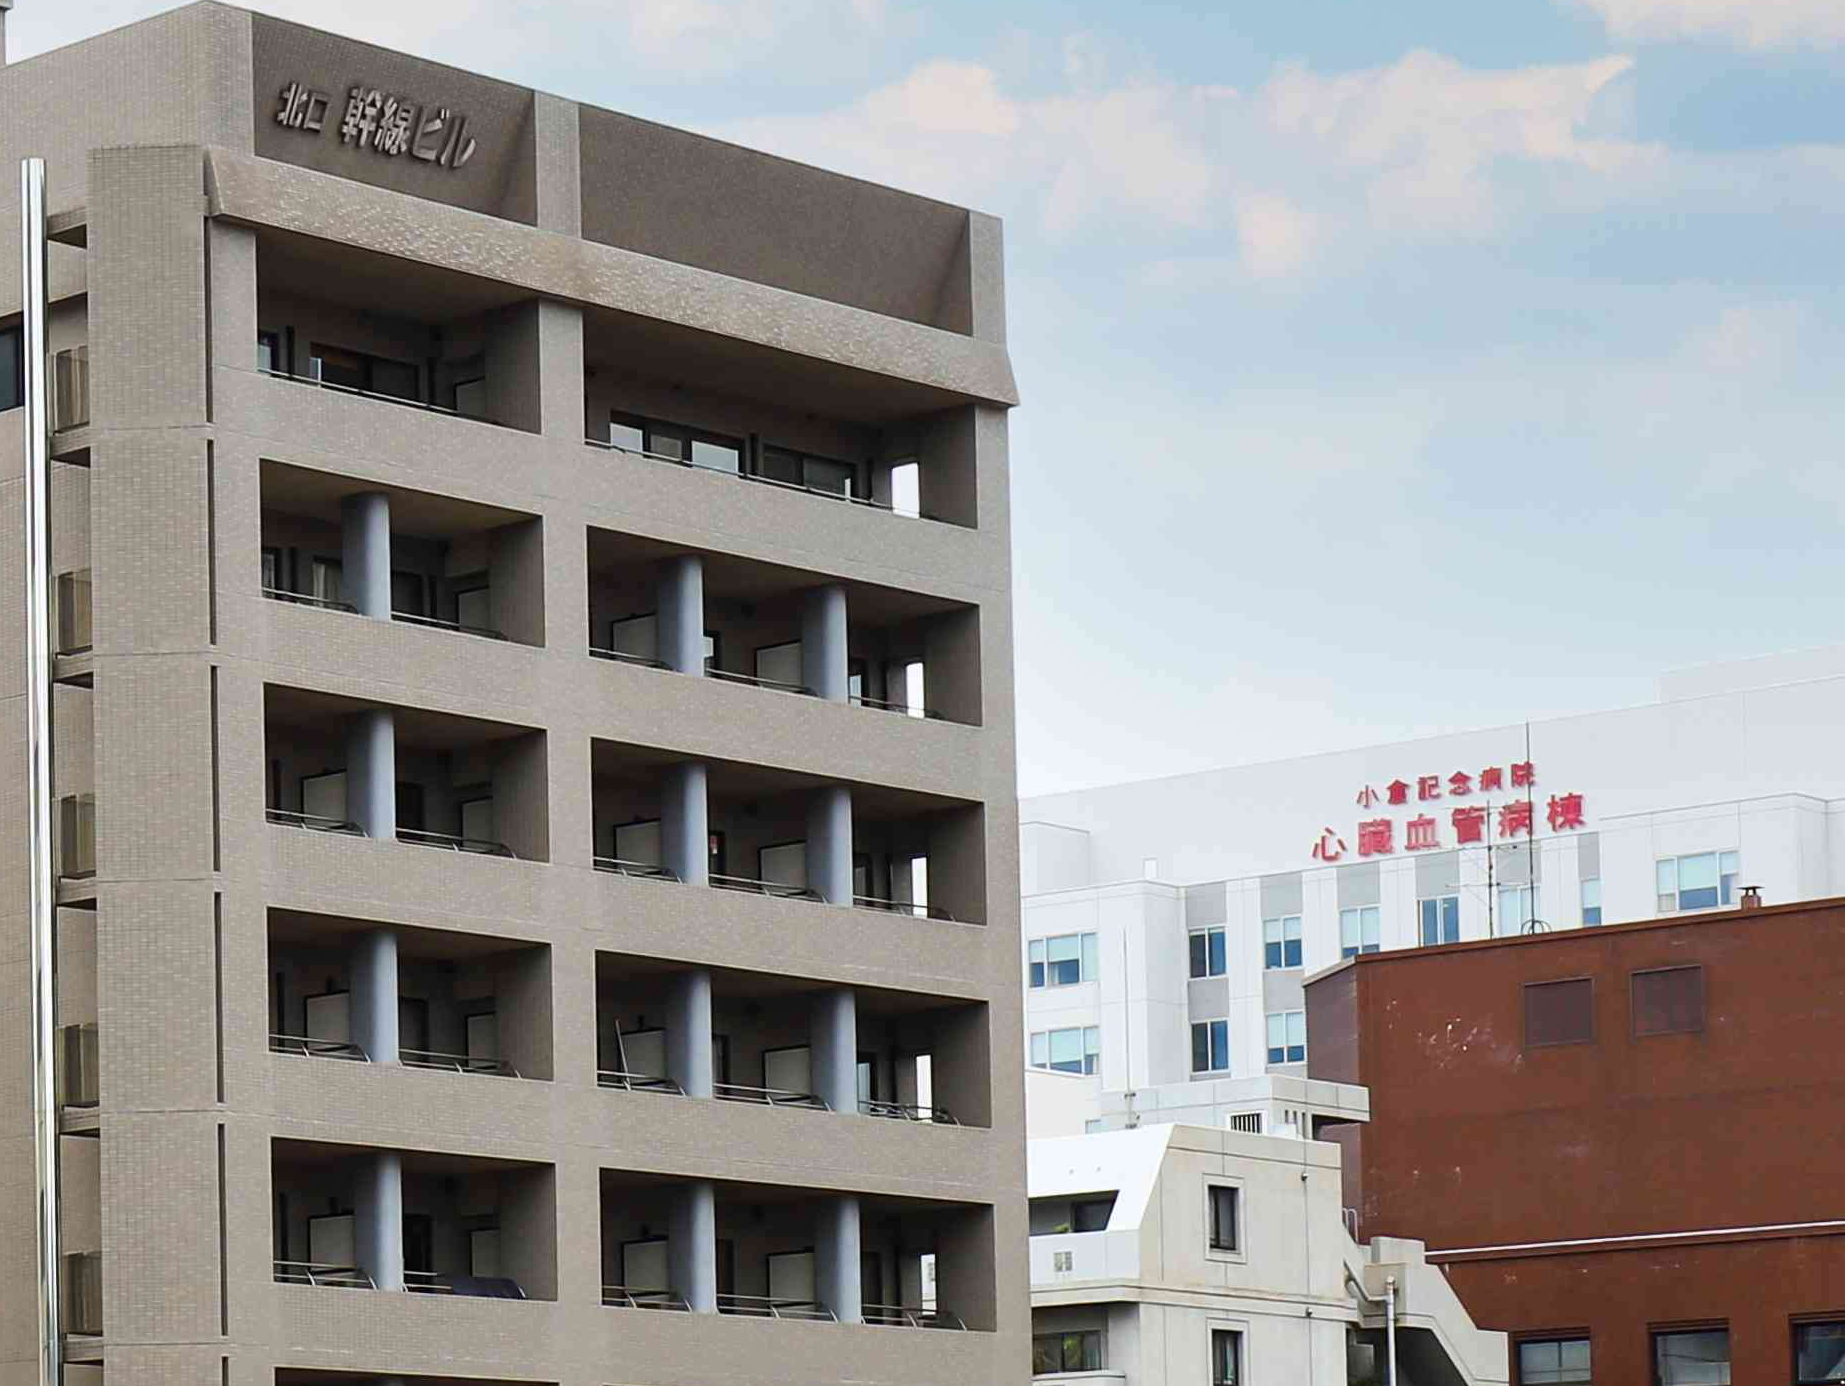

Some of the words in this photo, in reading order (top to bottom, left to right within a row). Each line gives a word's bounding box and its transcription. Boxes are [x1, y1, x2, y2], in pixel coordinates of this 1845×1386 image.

[341, 86, 477, 168] 幹線ビル
[1356, 760, 1536, 810] 小倉記念病院
